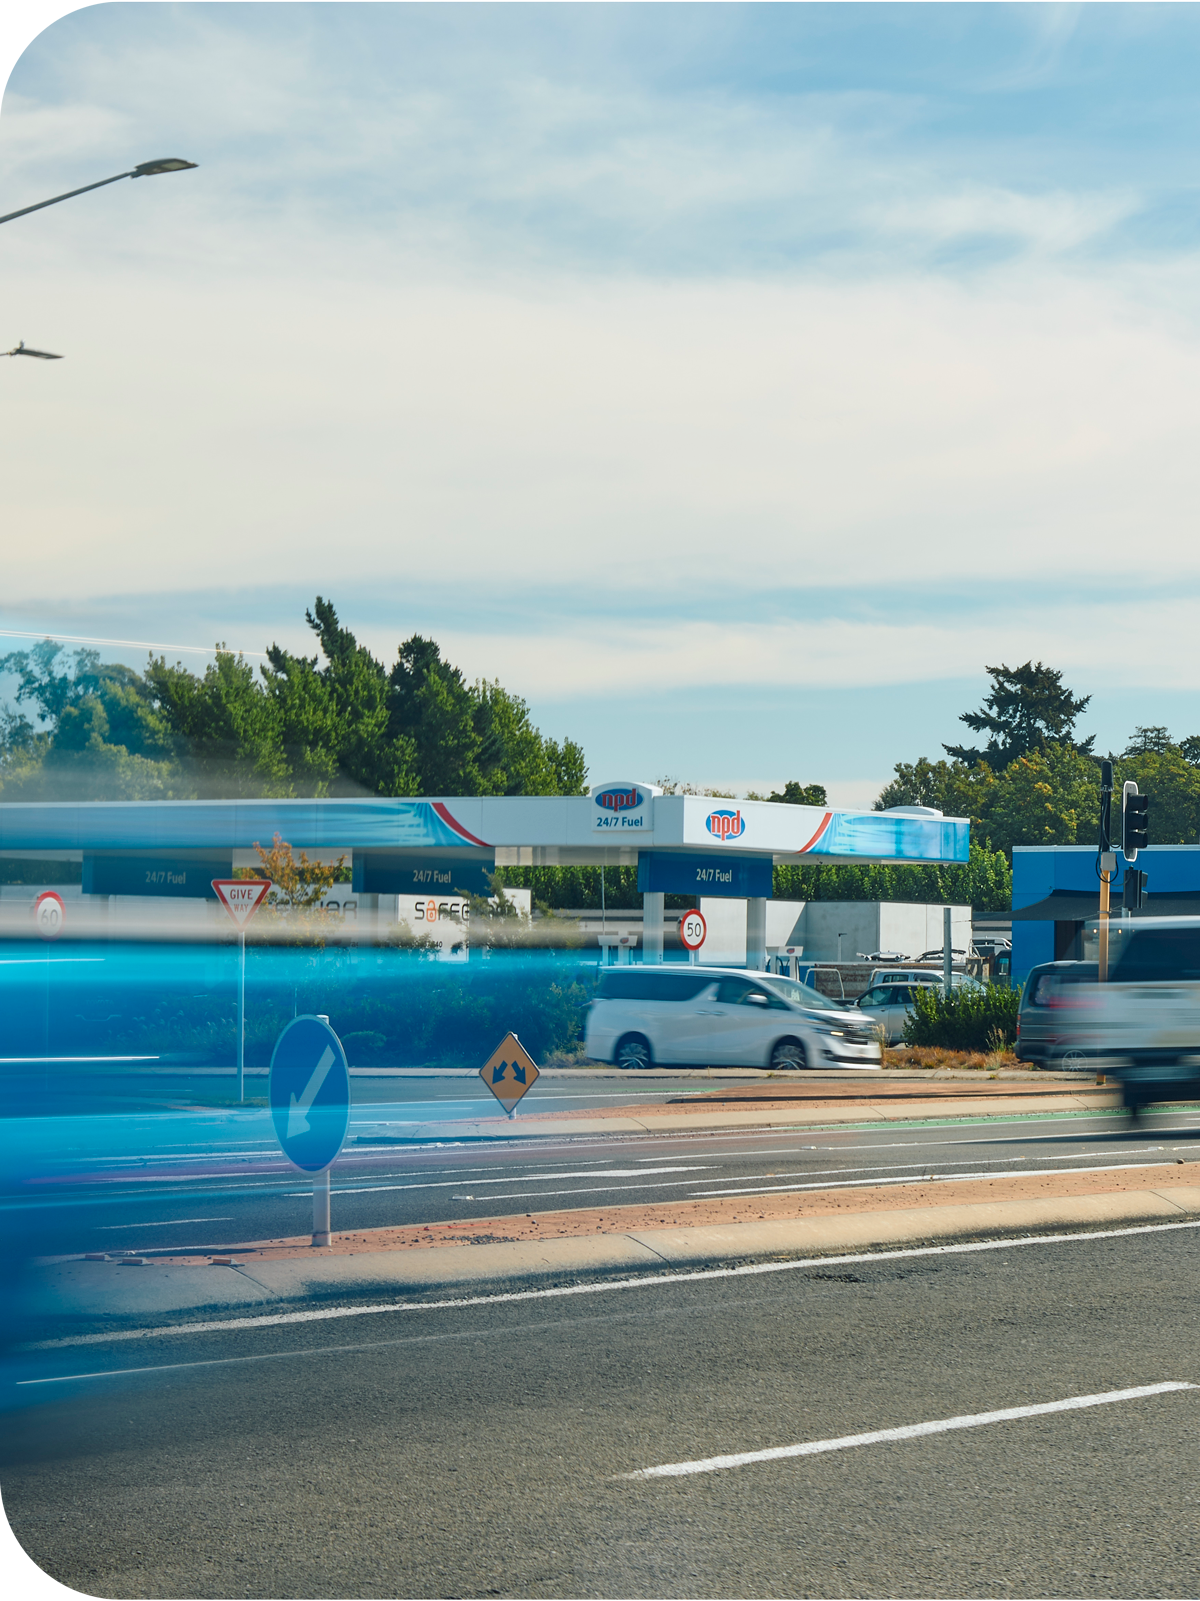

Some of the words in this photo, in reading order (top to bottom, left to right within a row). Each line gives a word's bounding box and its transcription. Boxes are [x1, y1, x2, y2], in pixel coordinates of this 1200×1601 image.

[601, 788, 637, 812] npd
[596, 817, 619, 828] 24/7
[621, 816, 643, 827] Fuel
[710, 810, 741, 841] npd
[145, 871, 165, 884] 24/7
[167, 872, 186, 885] Fuel
[413, 869, 432, 883] 24/7
[433, 870, 451, 883] Fuel
[696, 868, 714, 882] 24/7
[715, 869, 732, 883] Fuel
[230, 888, 253, 900] GIVE
[233, 903, 249, 913] WAY
[41, 908, 59, 927] 60
[686, 922, 702, 938] 50
